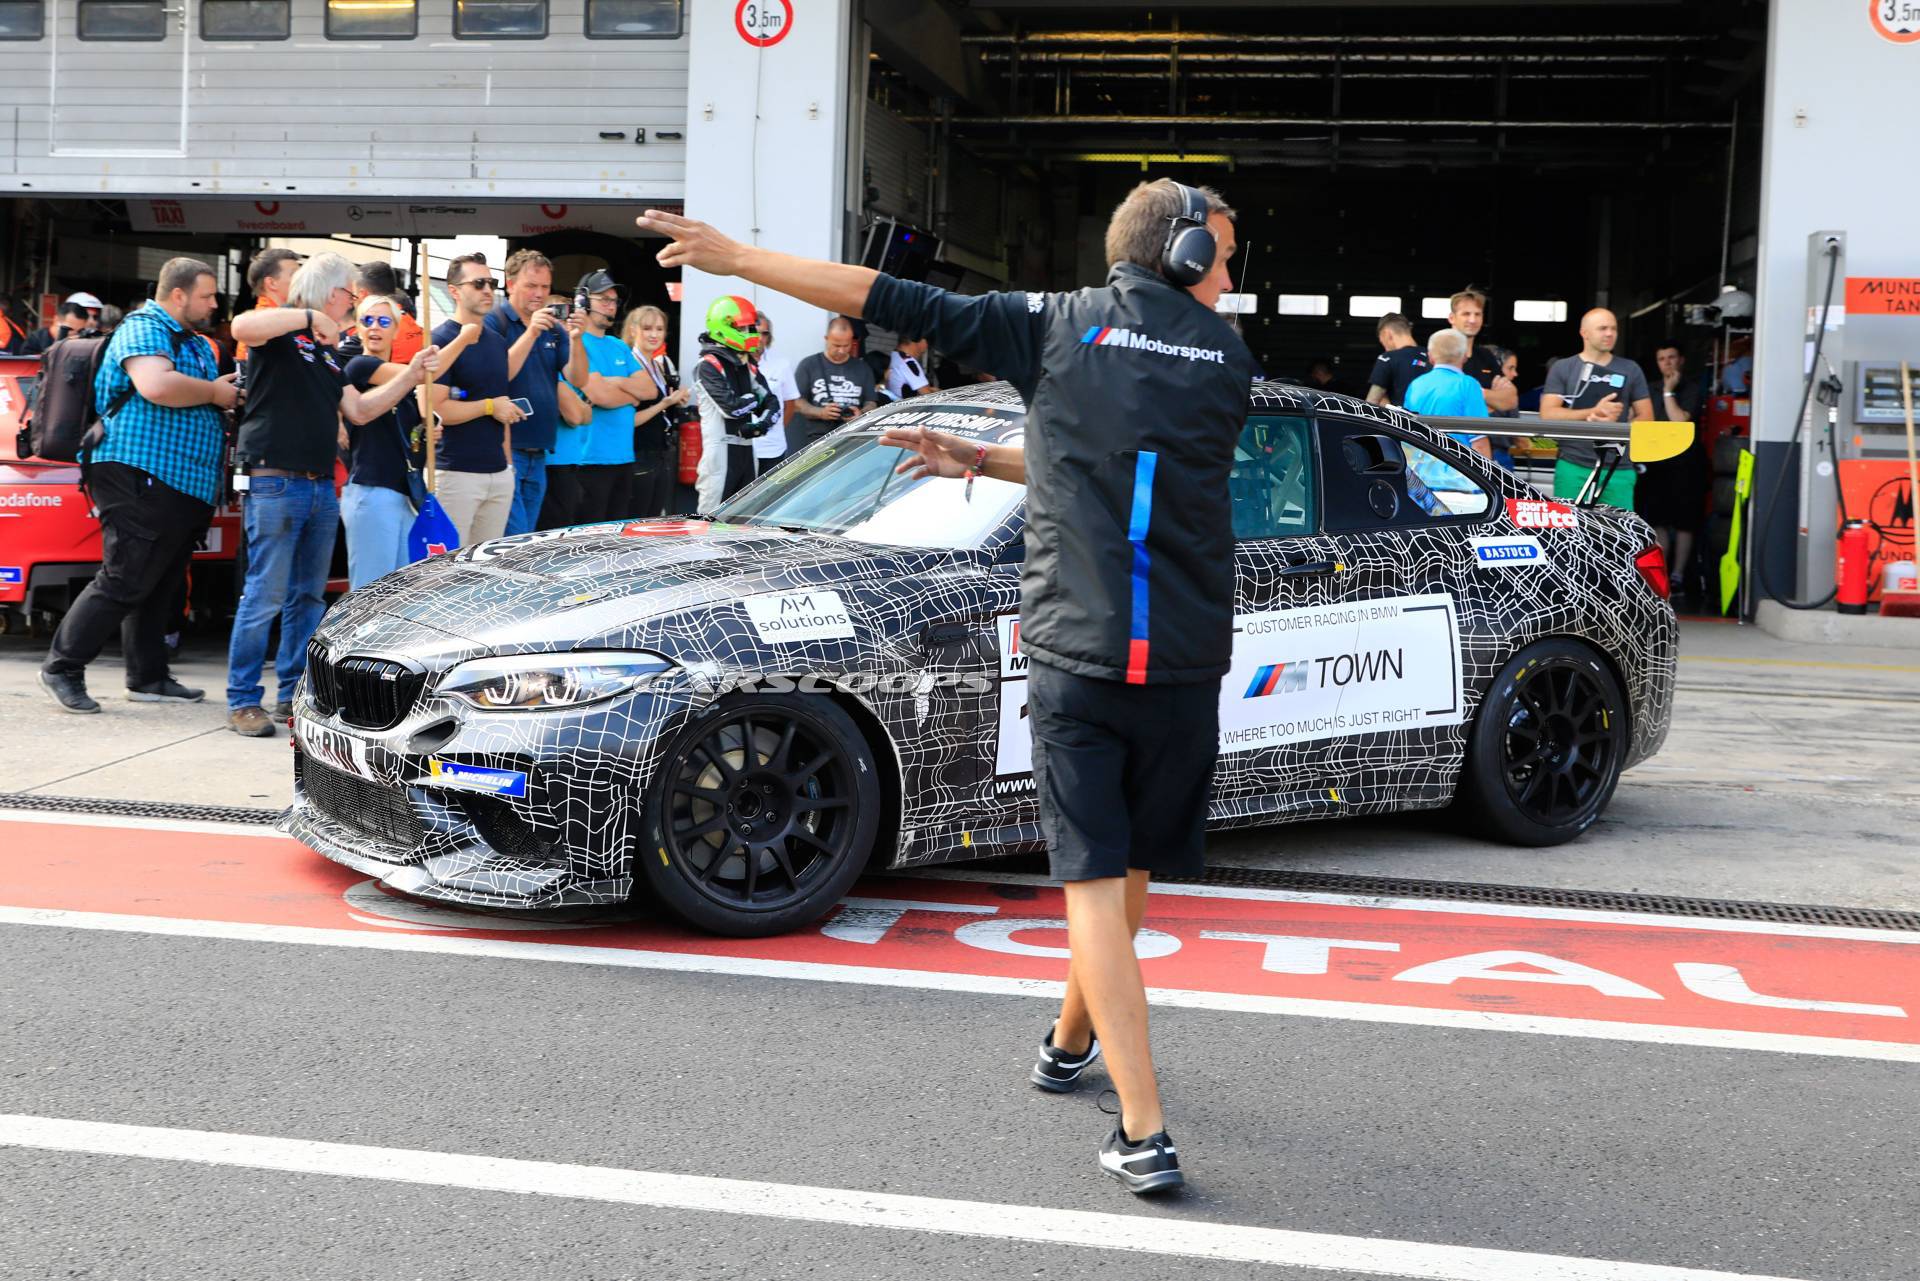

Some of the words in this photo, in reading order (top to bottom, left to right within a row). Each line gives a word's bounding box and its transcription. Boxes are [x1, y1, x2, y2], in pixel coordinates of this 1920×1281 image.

[746, 4, 782, 28] 3.5m
[152, 206, 186, 224] TAXI
[1130, 332, 1225, 364] Motorsport
[1516, 501, 1549, 512] sport
[1516, 510, 1580, 527] auto
[1484, 546, 1532, 559] BASTUCK
[781, 595, 816, 614] AM
[759, 613, 847, 632] solutions
[1246, 616, 1313, 635] CUSTOMER
[1315, 610, 1357, 626] RACING
[1357, 608, 1369, 621] IN
[1371, 606, 1398, 620] BMW
[1314, 648, 1403, 688] TOWN
[1224, 724, 1267, 744] WHERE
[1269, 721, 1295, 738] TOO
[1297, 716, 1333, 735] MUCH
[1334, 715, 1346, 728] IS
[1348, 711, 1380, 727] JUST
[1381, 708, 1421, 725] RIGHT
[457, 770, 515, 788] MICHELIN
[820, 896, 1907, 1019] TOTAL
